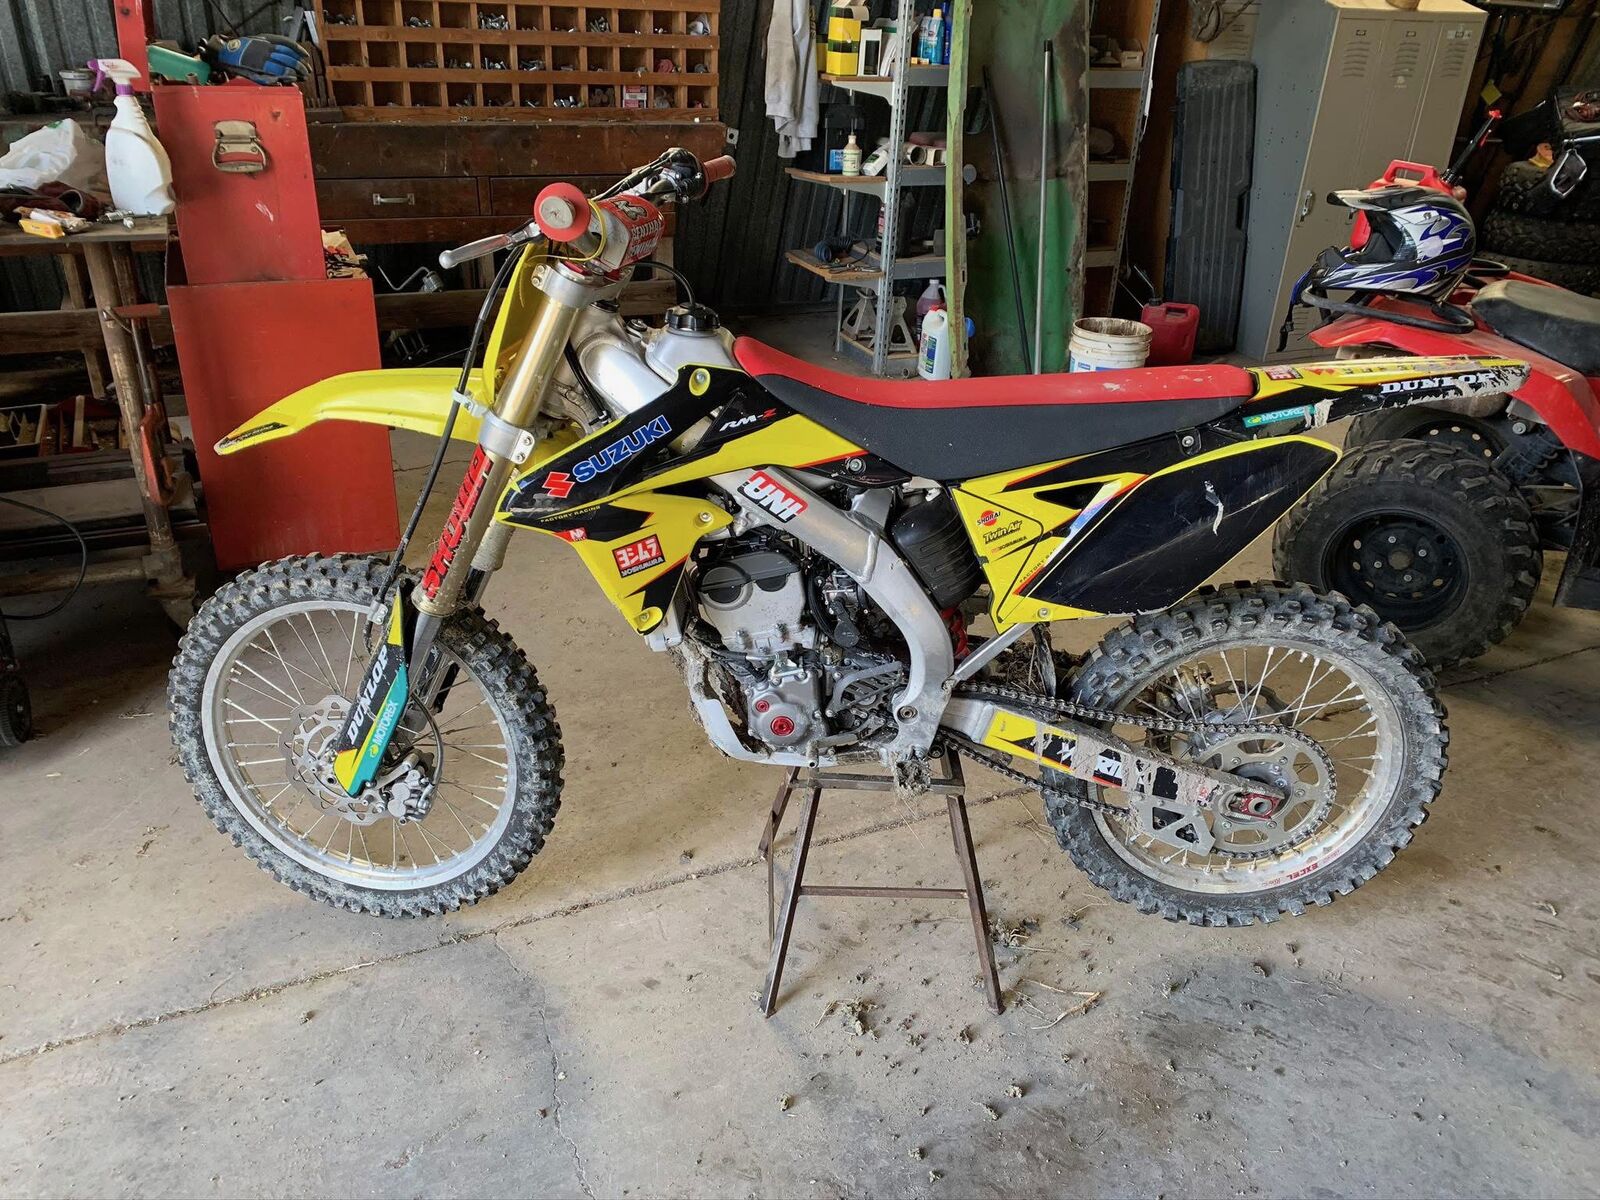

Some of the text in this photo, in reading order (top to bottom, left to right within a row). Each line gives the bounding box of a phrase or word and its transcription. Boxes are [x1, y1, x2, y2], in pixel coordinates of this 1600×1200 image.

[573, 415, 672, 483] SUZUKI
[540, 505, 601, 523] FACTORY RACING
[743, 476, 803, 521] UNI
[983, 520, 1023, 544] Twin Air
[621, 556, 664, 577] YOSHIMURA
[347, 644, 389, 745] DUNLOP
[372, 701, 399, 746] MOTOREX
[1286, 862, 1319, 880] EXCEL
